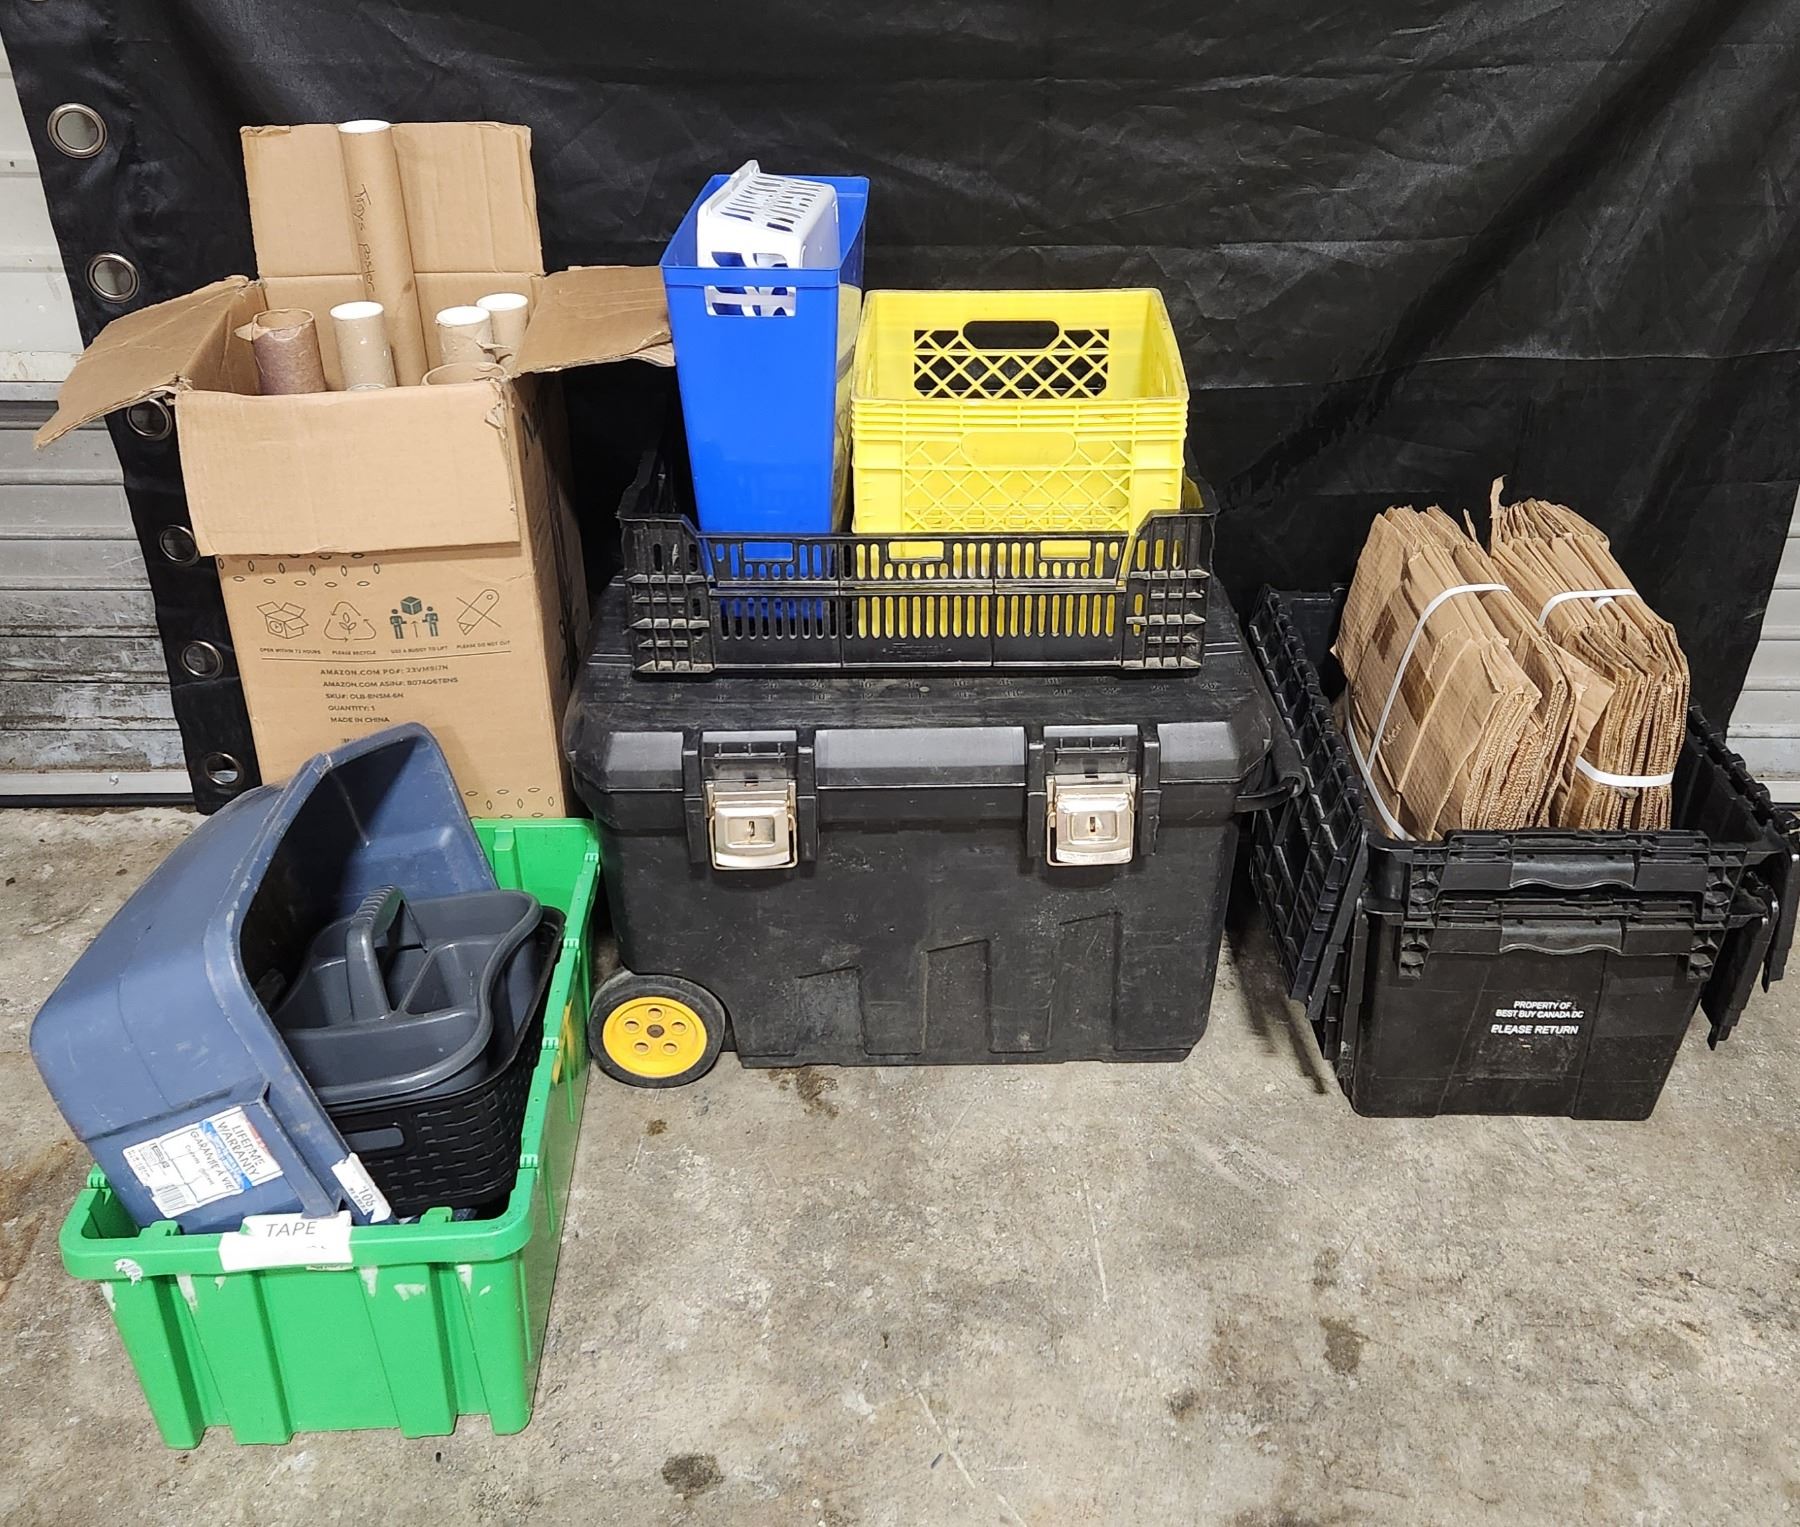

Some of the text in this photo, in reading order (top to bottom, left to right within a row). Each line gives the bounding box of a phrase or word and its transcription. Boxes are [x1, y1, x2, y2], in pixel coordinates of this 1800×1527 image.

[323, 680, 378, 688] AMAZON.COM
[1513, 1001, 1573, 1010] PROPERTY OF
[1495, 1009, 1585, 1019] BEST BUY CANADA DC
[1490, 1024, 1579, 1035] PLEASE RETURN
[265, 1221, 319, 1238] TAPE
